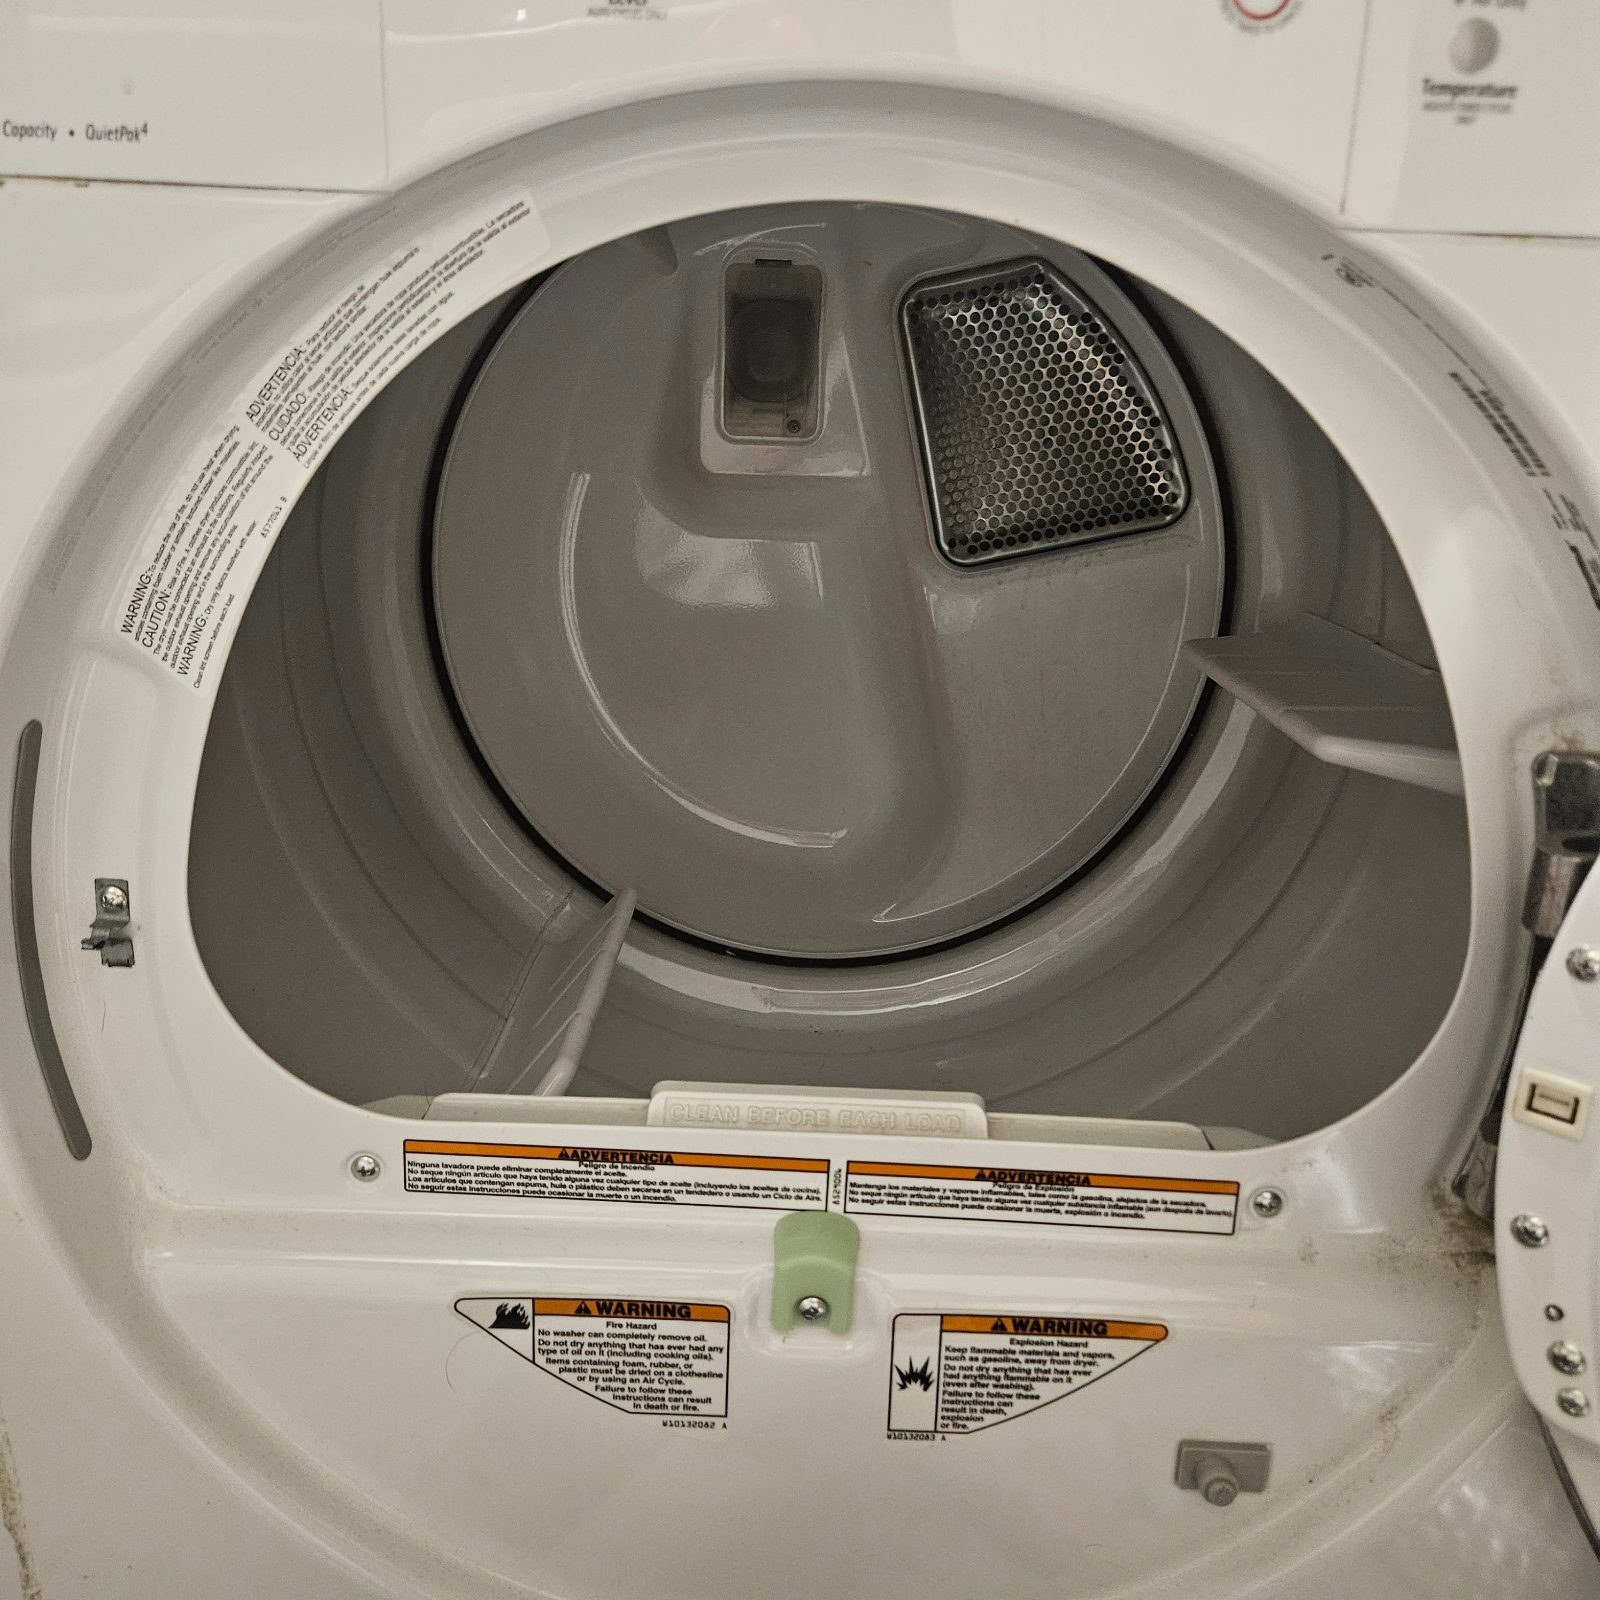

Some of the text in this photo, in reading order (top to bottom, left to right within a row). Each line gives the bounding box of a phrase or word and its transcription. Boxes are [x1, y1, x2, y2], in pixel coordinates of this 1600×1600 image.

[2, 119, 57, 143] Capacity
[246, 346, 306, 422] ADVERTENCIA:
[121, 569, 153, 634] WARNING:
[142, 589, 171, 648] CAUTION:
[167, 576, 178, 589] Risk
[175, 567, 181, 576] of
[177, 614, 209, 676] WARNING:
[204, 604, 214, 615] Dry
[210, 591, 220, 604] only
[215, 572, 228, 590] fabrics
[226, 549, 240, 572] washed
[239, 537, 247, 549] with
[193, 671, 203, 688] Clean
[199, 661, 207, 671] lint
[204, 642, 213, 661] screen
[210, 622, 222, 643] before
[219, 607, 228, 622] each
[669, 1103, 961, 1133] CLEAN BEFORE EACH LOAD
[571, 1149, 675, 1164] ADVERTENCIA
[407, 1160, 626, 1177] Ninguna lavadora puede eliminar completamente el aceite.
[578, 1162, 656, 1171] Peligro de Incendio
[988, 1171, 1091, 1186] ADVERTENCIA
[407, 1182, 521, 1195] No seguir estas instrucciones
[992, 1181, 1021, 1192] Peligro
[1034, 1183, 1075, 1194] Explosión
[595, 1301, 692, 1317] WARNING
[606, 1321, 657, 1330] Fire Hazard
[1012, 1320, 1107, 1336] WARNING
[538, 1328, 551, 1337] No
[552, 1329, 585, 1338] washer
[606, 1331, 656, 1342] completely
[693, 1334, 706, 1342] oil.
[538, 1338, 551, 1347] Do
[553, 1339, 568, 1347] not
[569, 1339, 585, 1350] dry
[587, 1340, 627, 1351] anything
[628, 1341, 646, 1350] that
[648, 1342, 665, 1350] has
[688, 1343, 706, 1352] had
[707, 1346, 724, 1354] any
[1009, 1338, 1089, 1349] Explosion Hazard
[537, 1347, 558, 1357] type
[559, 1347, 569, 1356] of
[571, 1348, 583, 1356] oil
[598, 1349, 605, 1357] it
[606, 1349, 652, 1360] (including
[653, 1350, 690, 1361] cooking
[691, 1351, 713, 1362] oils).
[944, 1345, 1115, 1361] Keep flammable materials and vapors,
[545, 1357, 571, 1365] Items
[572, 1357, 620, 1369] containing
[622, 1359, 647, 1370] foam,
[649, 1360, 681, 1371] rubber,
[944, 1354, 966, 1362] such
[981, 1355, 1022, 1366] gasoline,
[1024, 1358, 1047, 1367] away
[1049, 1357, 1071, 1366] from
[1072, 1358, 1099, 1369] dryer.
[558, 1365, 589, 1376] plastic
[590, 1366, 613, 1375] must
[615, 1367, 626, 1375] be
[628, 1367, 652, 1376] dried
[674, 1369, 724, 1378] clothesline
[943, 1363, 957, 1372] Do
[958, 1364, 974, 1372] not
[975, 1364, 990, 1375] dry
[992, 1365, 1032, 1376] anything
[1033, 1366, 1052, 1375] that
[1053, 1367, 1070, 1375] has
[588, 1374, 600, 1384] by
[601, 1375, 627, 1385] using
[642, 1376, 655, 1384] Air
[657, 1376, 685, 1387] Cycle.
[943, 1371, 960, 1380] had
[961, 1372, 1002, 1383] anything
[1003, 1373, 1050, 1383] flammable
[1065, 1375, 1073, 1383] it
[594, 1384, 693, 1395] Failure to follow these
[942, 1380, 1034, 1392] (even after washing).
[612, 1393, 666, 1402] instructions
[686, 1395, 712, 1404] result
[942, 1389, 1041, 1400] Failure to follow these
[633, 1401, 642, 1409] in
[643, 1401, 669, 1410] death
[682, 1403, 700, 1411] fire.
[941, 1398, 995, 1406] instructions
[941, 1405, 1007, 1417] result in death,
[940, 1413, 984, 1424] explosion
[952, 1421, 969, 1429] fire.
